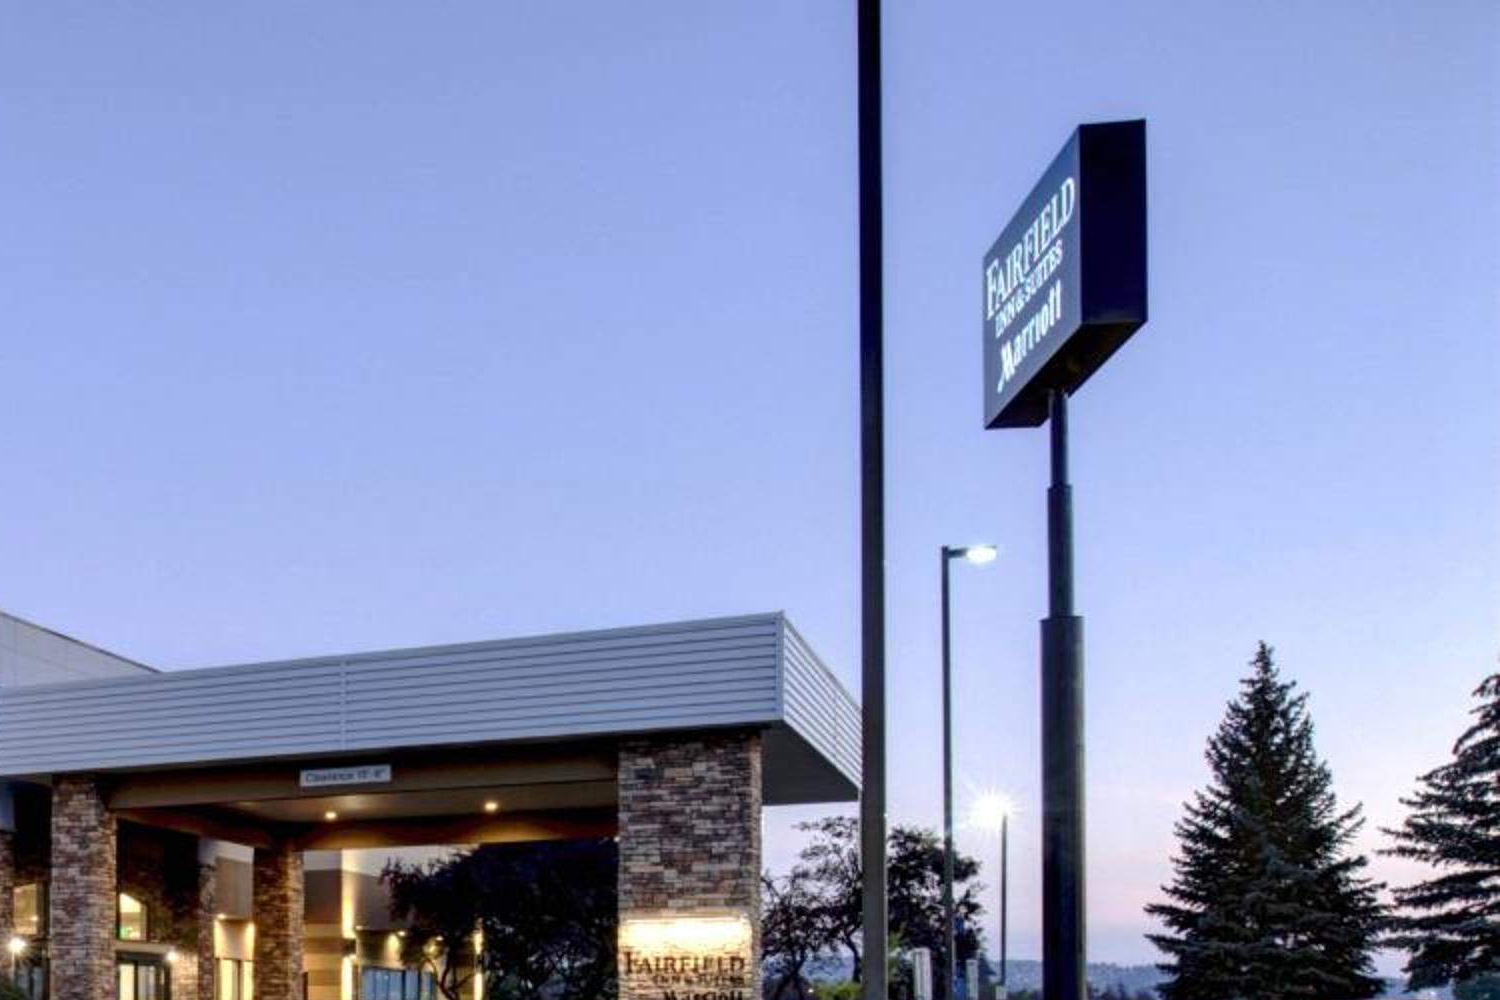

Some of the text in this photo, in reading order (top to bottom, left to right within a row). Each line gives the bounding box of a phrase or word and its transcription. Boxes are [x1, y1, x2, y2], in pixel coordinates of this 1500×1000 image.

[986, 177, 1076, 321] FAIRFIELD
[995, 298, 1017, 339] INN
[1023, 239, 1063, 303] SUITES
[997, 279, 1062, 394] Marriott
[623, 951, 746, 975] FAIRFIELD
